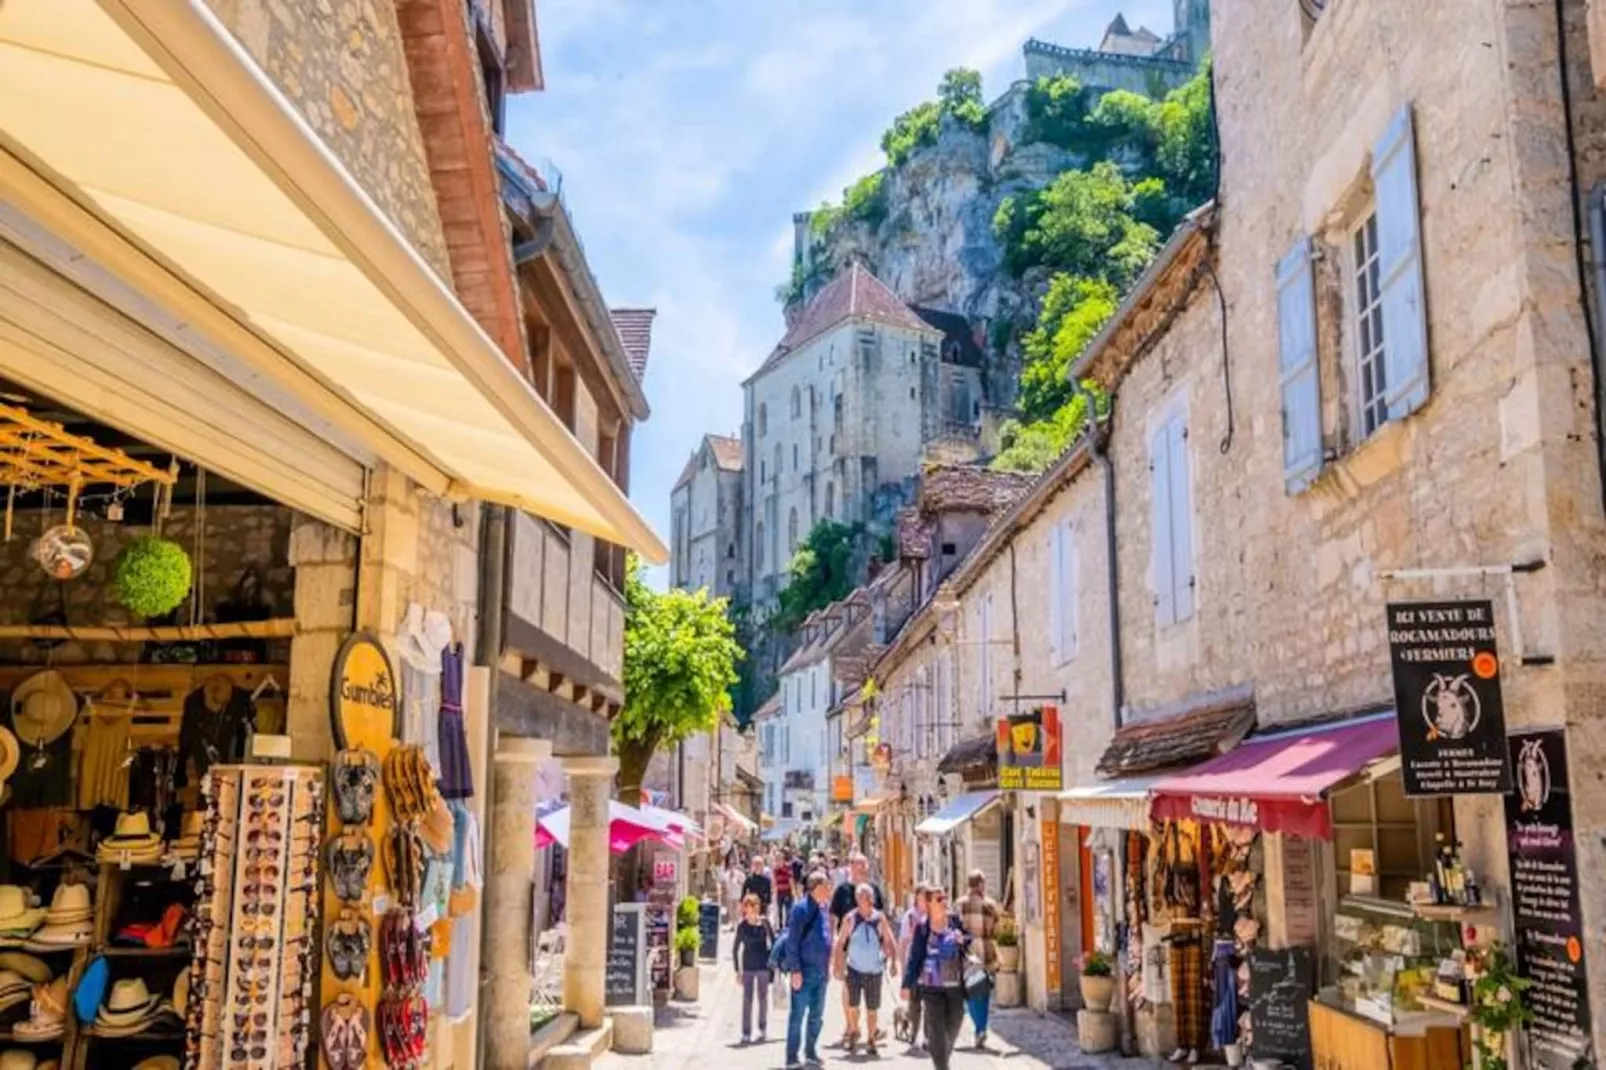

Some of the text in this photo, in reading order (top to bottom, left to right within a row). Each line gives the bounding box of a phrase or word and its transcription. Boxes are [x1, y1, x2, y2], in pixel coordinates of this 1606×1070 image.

[1396, 608, 1485, 623] ICI VENTE DE
